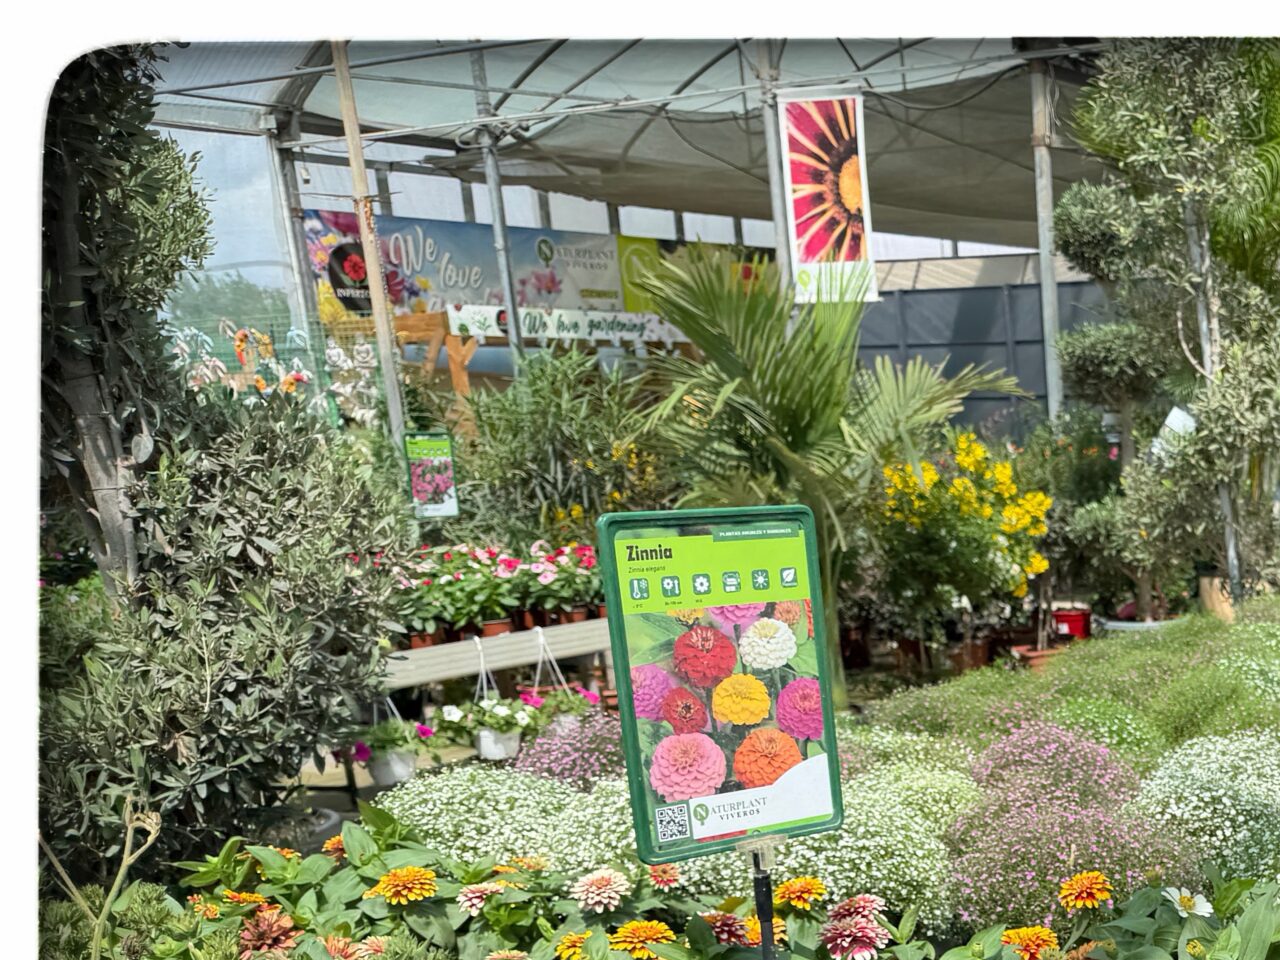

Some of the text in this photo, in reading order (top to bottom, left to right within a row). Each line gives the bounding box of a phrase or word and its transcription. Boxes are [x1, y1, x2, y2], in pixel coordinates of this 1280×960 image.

[389, 224, 437, 277] We
[439, 251, 483, 290] love
[523, 312, 547, 334] We
[587, 316, 648, 338] gardening
[626, 544, 673, 562] Zinnia
[693, 796, 767, 822] NATURPLANT
[720, 808, 761, 821] VIVEROS
